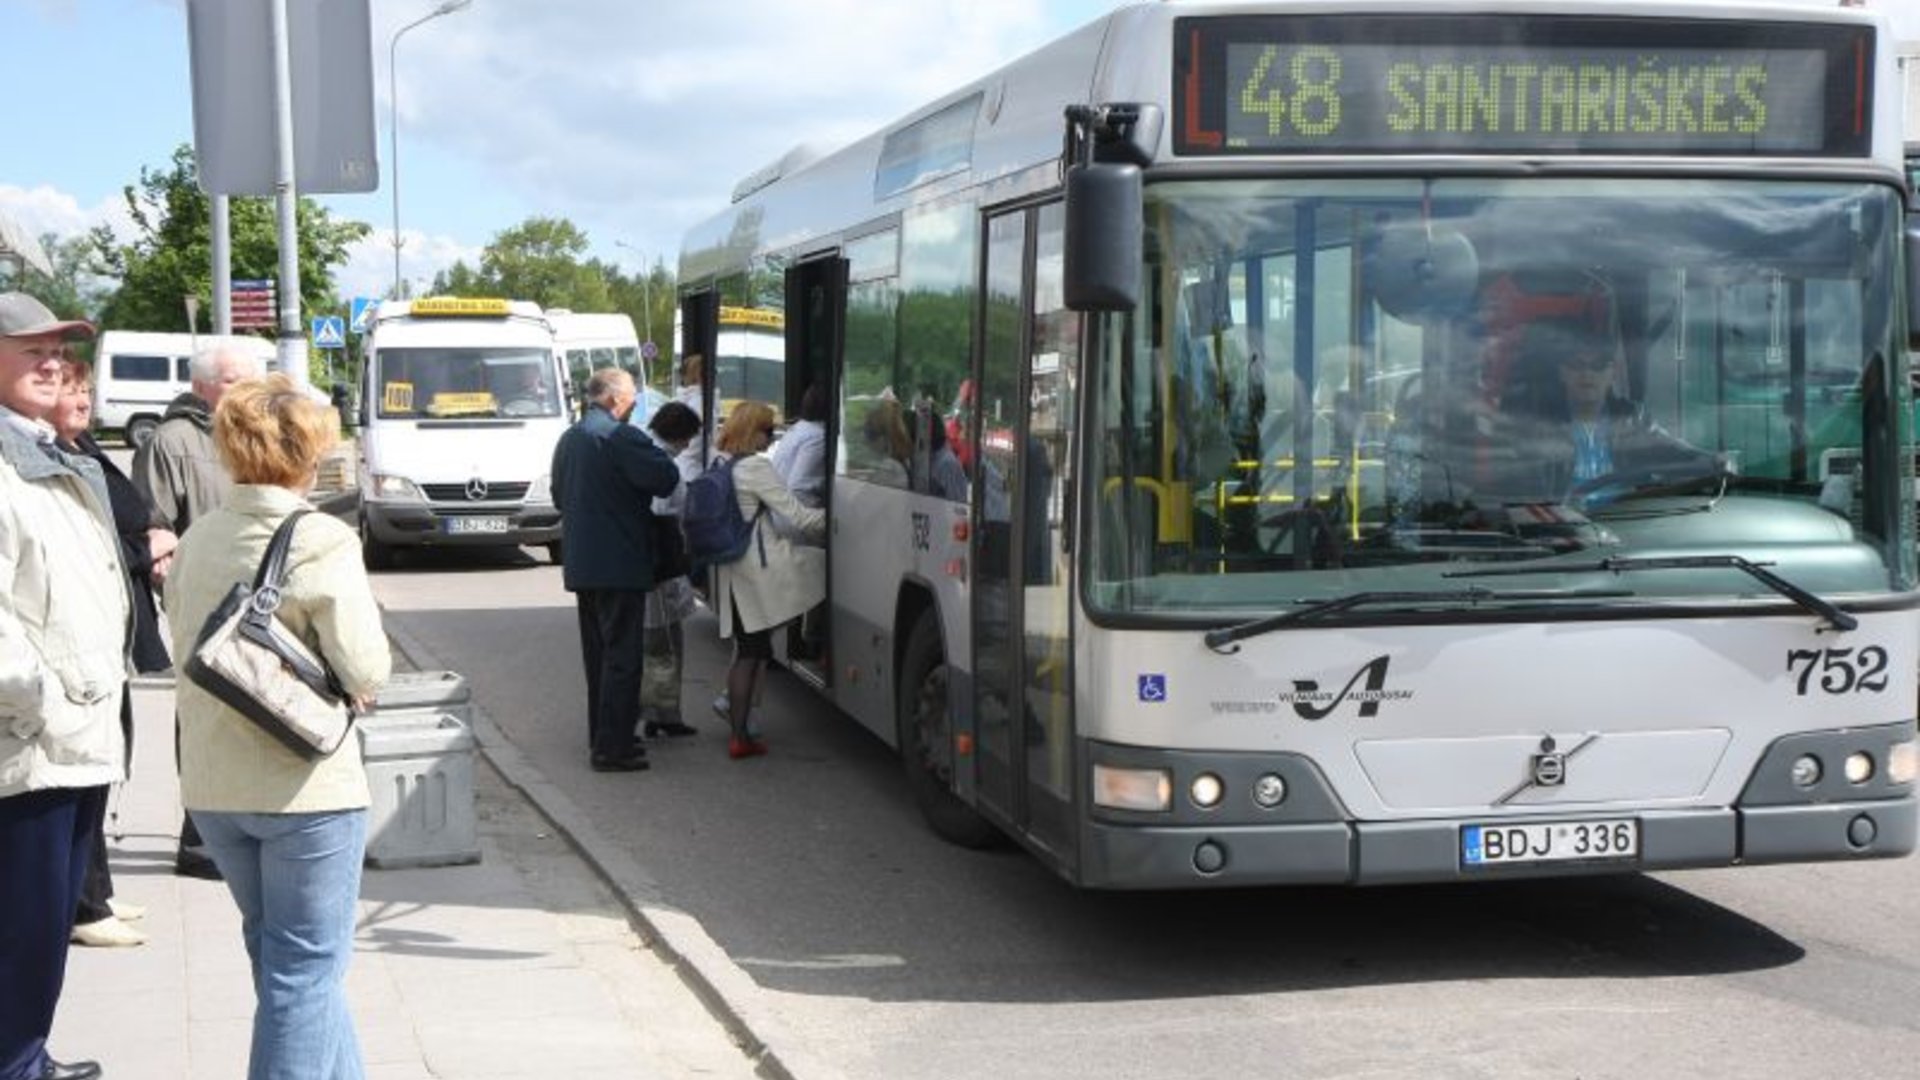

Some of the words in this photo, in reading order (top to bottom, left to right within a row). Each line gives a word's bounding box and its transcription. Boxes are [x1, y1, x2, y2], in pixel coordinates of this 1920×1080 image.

[1241, 43, 1341, 135] 48
[1387, 55, 1768, 132] SANTARIŠKĖS
[1787, 645, 1889, 696] 752
[1484, 827, 1551, 859] BDJ
[1573, 823, 1631, 854] 336
